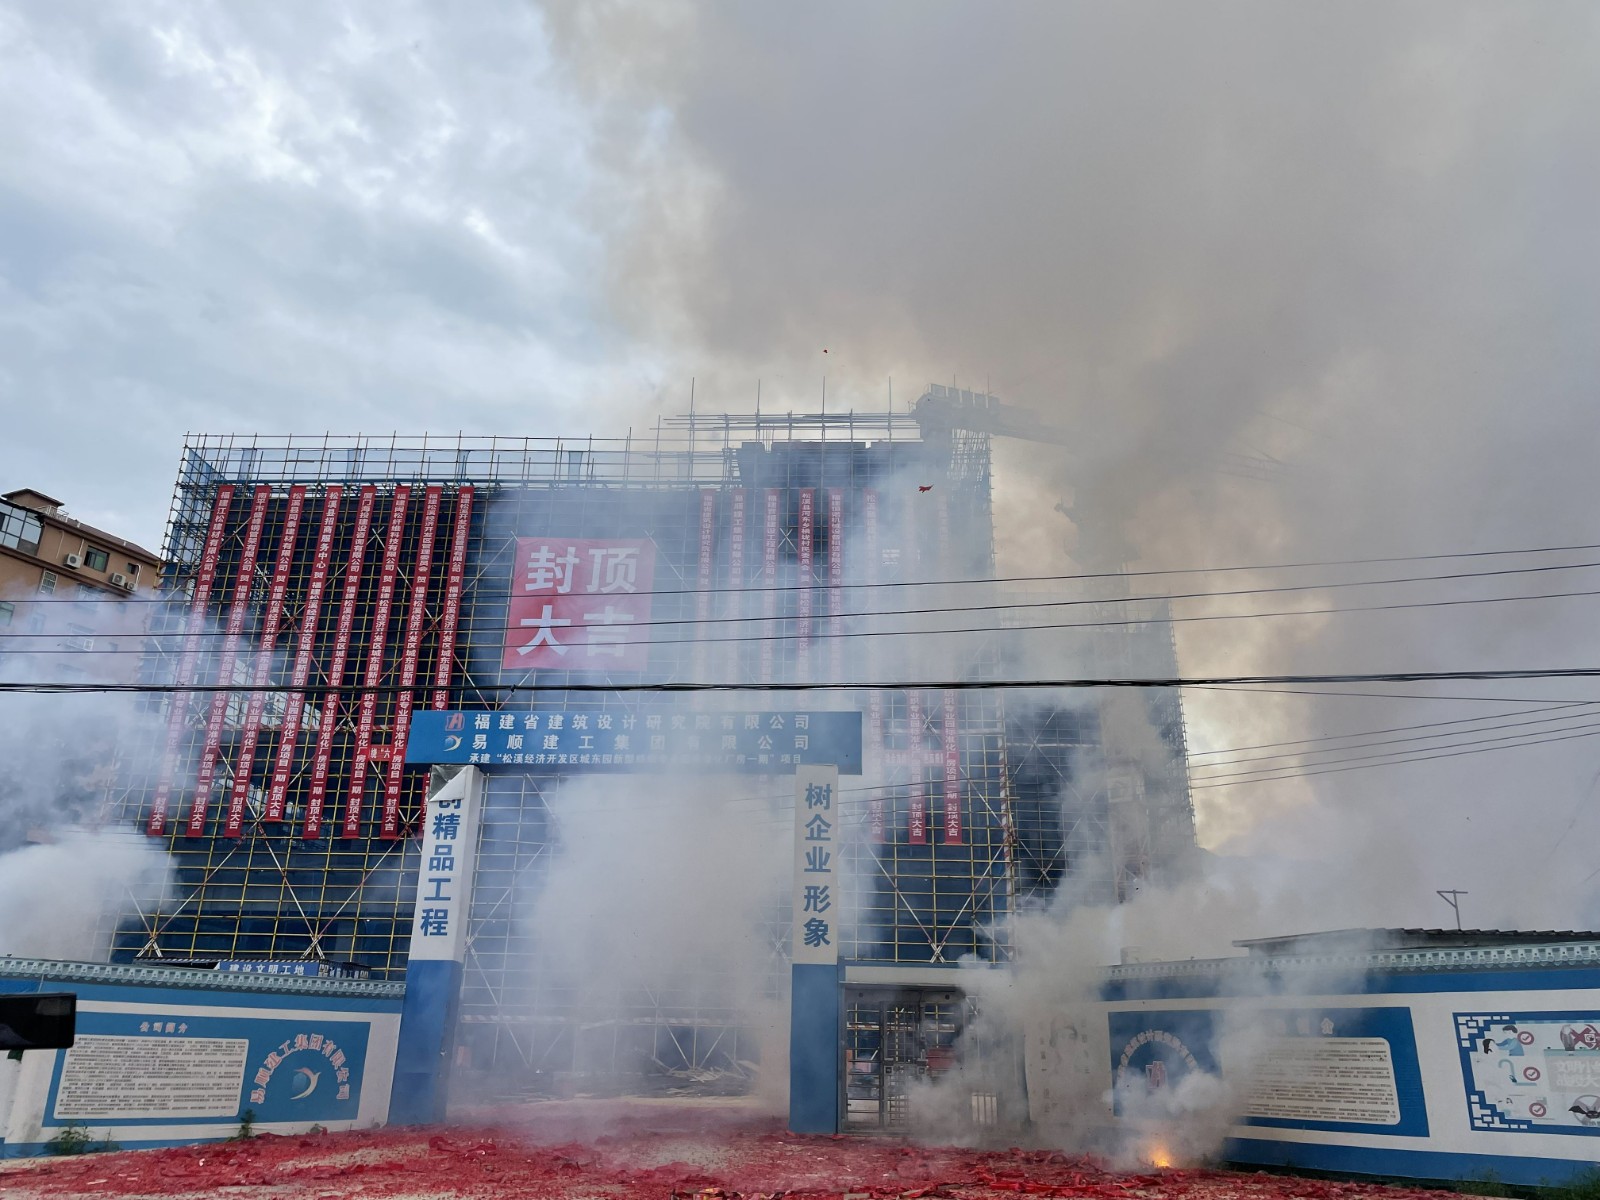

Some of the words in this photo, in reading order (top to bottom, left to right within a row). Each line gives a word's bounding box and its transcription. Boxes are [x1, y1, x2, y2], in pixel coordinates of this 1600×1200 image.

[316, 492, 338, 568] 松溪县招商服务中心
[418, 494, 438, 572] 福建松溪经济开发区管理委员会
[526, 546, 640, 594] 封顶
[516, 605, 634, 656] 大吉
[198, 585, 248, 792] 福建松溪经济开发区城东园新型织专业园标准化厂房项目一期
[236, 586, 284, 792] 福建松溪经济开发区城东园新型织专业园标准化厂房项目一期
[276, 582, 322, 782] 福建松溪经济开发区城东园新型纺专业园标准化厂房项目一期
[312, 586, 356, 794] 福建松溪经济开发区城东园新型织专业园标准化厂房项目一期
[352, 586, 392, 794] 福建松溪经济开发区城东园新型织专业园标准化厂房项目一期
[388, 586, 426, 794] 福建松溪经济开发区城东园新型织专业园标准化厂房项目一期
[474, 714, 809, 730] 福建省建筑设计研究院有限公司
[469, 752, 491, 763] 承建
[780, 754, 800, 764] 项目
[472, 734, 808, 750] 易顺建工集团有限公司
[152, 798, 166, 830] 封顶大吉
[192, 798, 206, 830] 封顶大吉
[229, 797, 244, 829] 封顶大吉
[270, 786, 284, 818] 封顶大吉
[307, 798, 321, 830] 封顶大吉
[347, 798, 360, 830] 封顶大吉
[384, 798, 398, 830] 封顶大吉
[872, 801, 882, 834] 封顶大吉
[912, 803, 922, 836] 封顶大吉
[948, 803, 958, 836] 封顶大吉
[804, 782, 832, 948] 树企业形象
[229, 964, 305, 976] 建设文明工地
